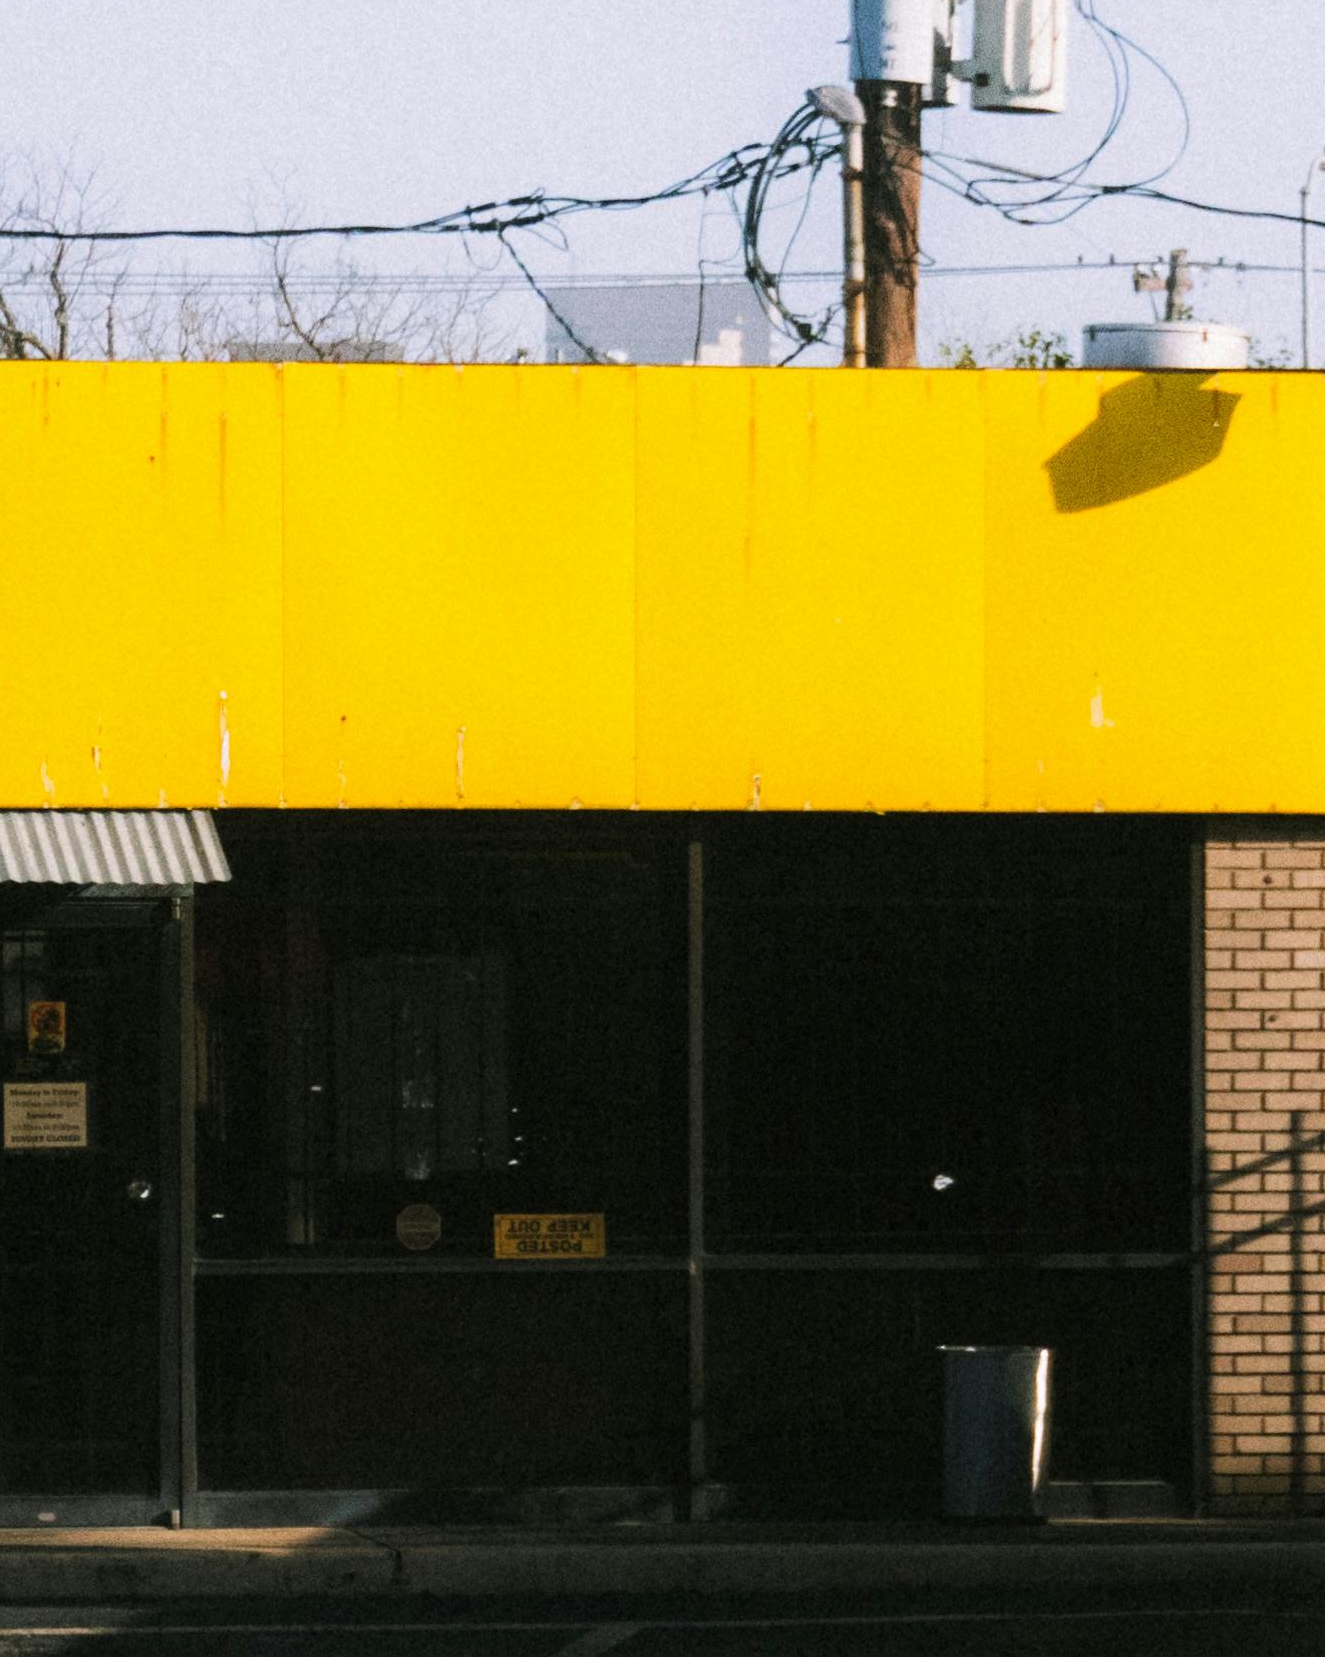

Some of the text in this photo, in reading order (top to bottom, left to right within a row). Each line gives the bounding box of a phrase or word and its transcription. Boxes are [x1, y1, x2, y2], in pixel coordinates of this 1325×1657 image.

[508, 1220, 590, 1233] KEEP OUT
[517, 1241, 583, 1254] POSTED
